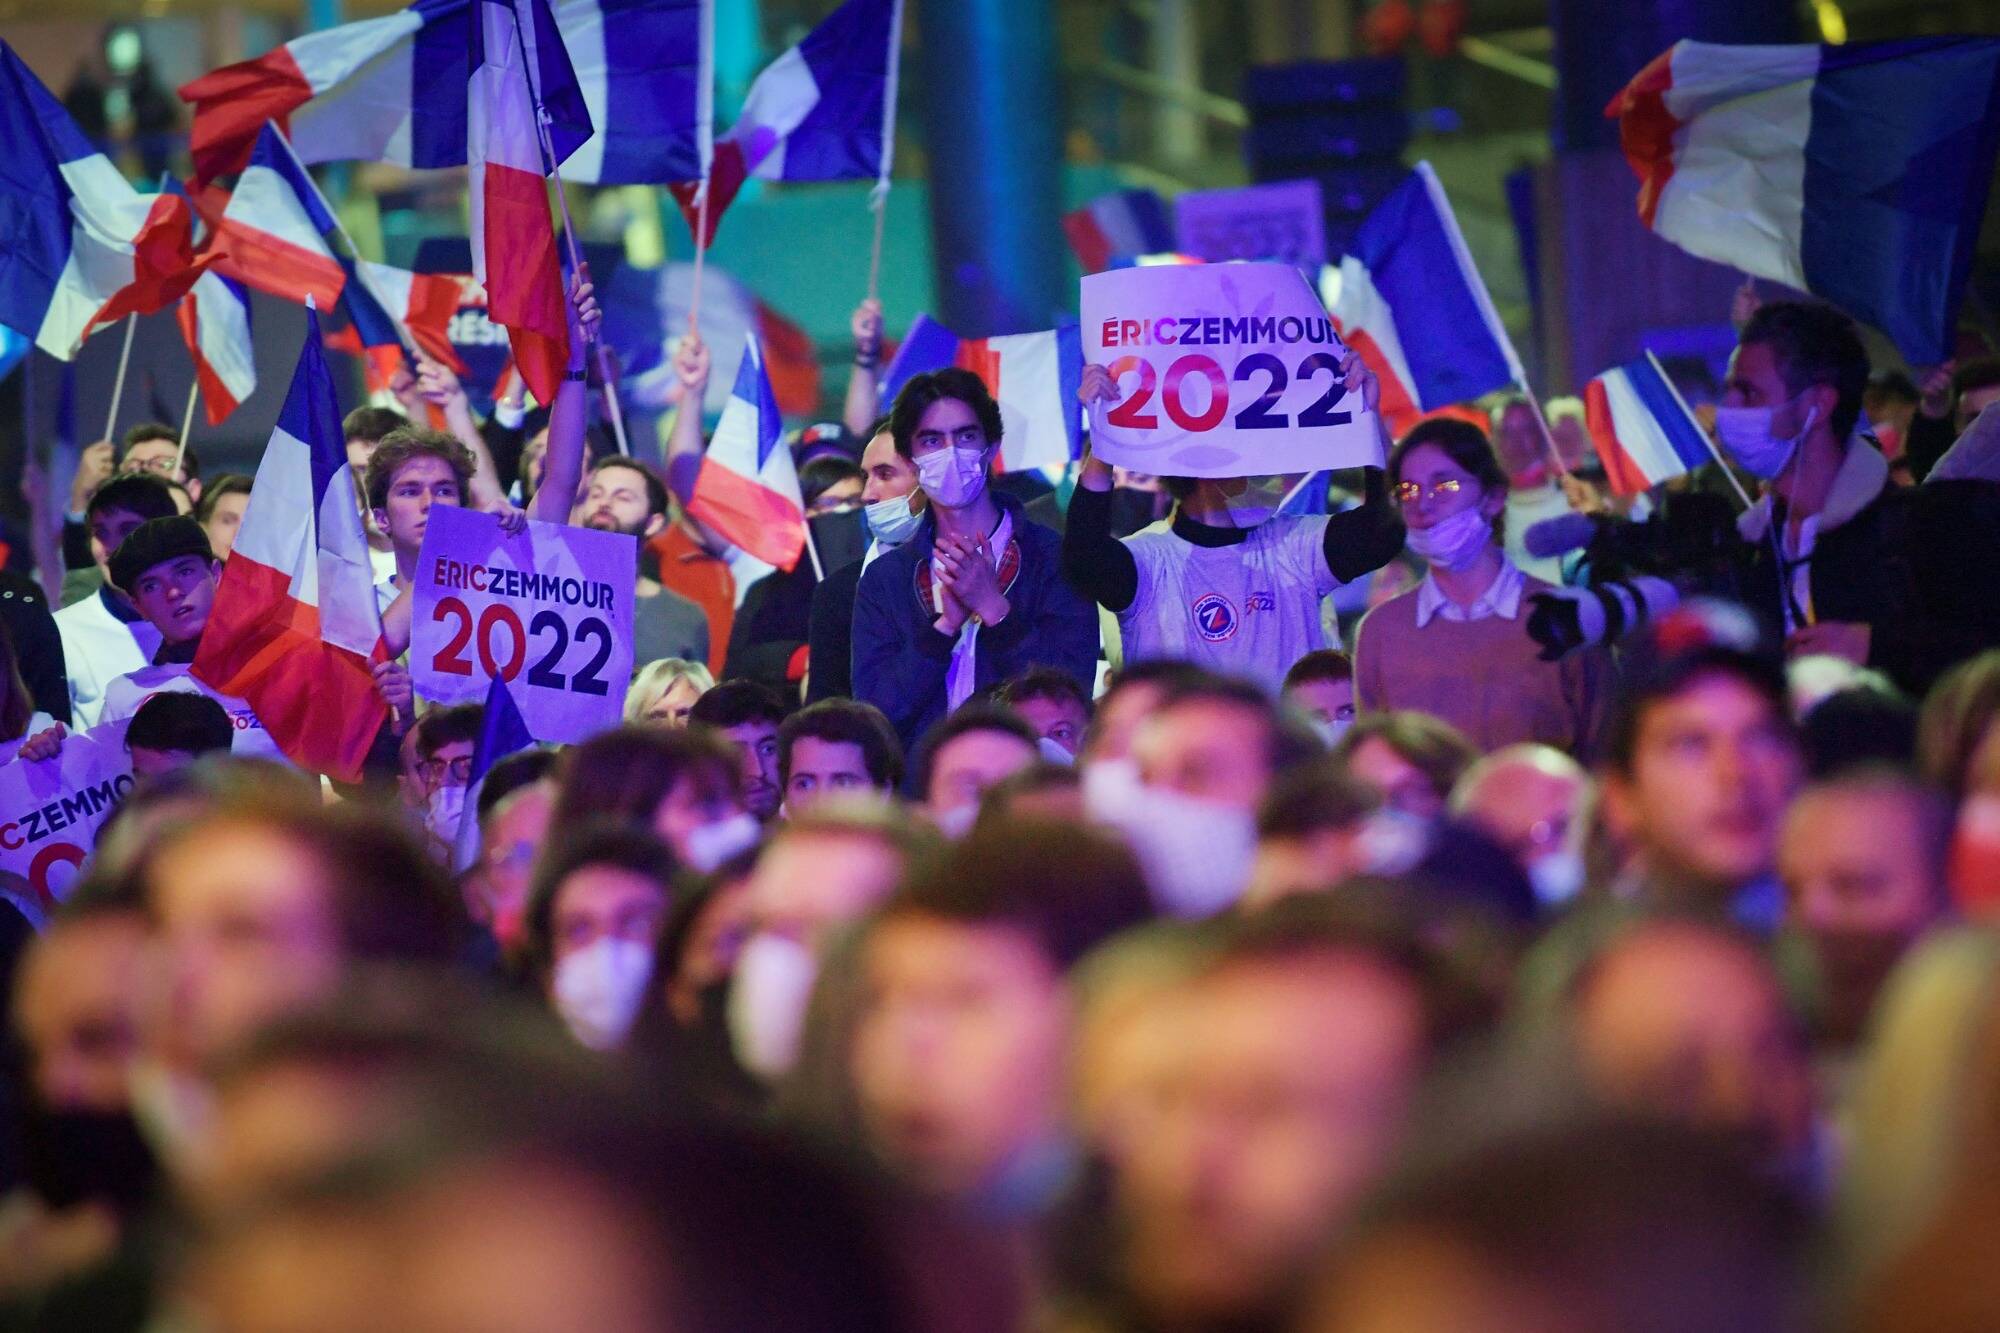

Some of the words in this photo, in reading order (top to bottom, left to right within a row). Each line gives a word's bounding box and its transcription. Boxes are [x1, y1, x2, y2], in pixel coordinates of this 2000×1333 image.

[1106, 352, 1353, 432] 2022
[433, 554, 614, 611] ÉRICZEMMOUR
[432, 596, 613, 696] 2022
